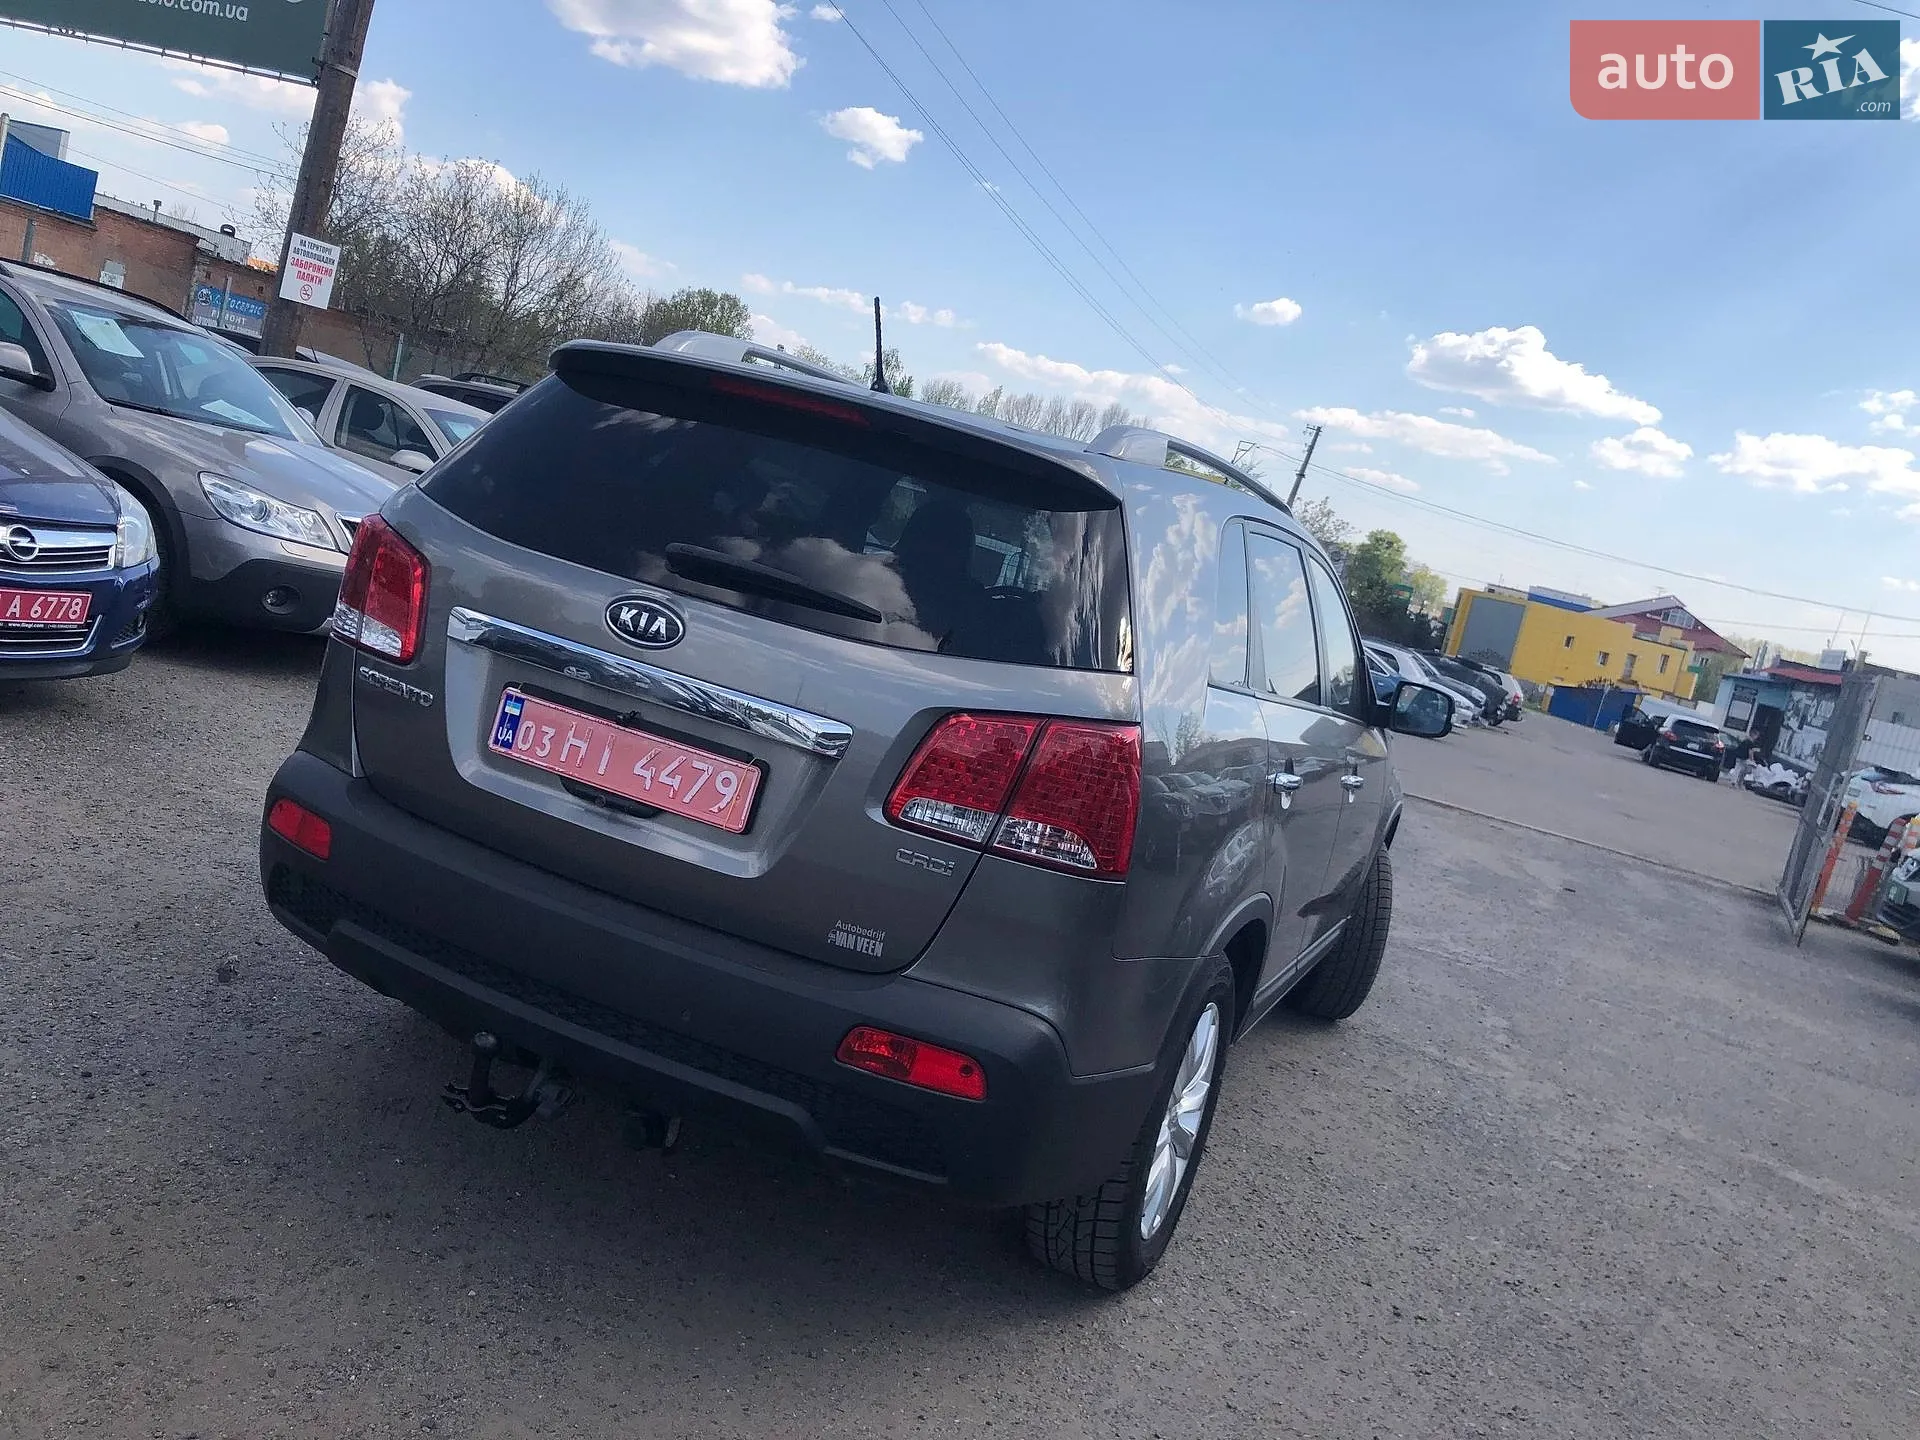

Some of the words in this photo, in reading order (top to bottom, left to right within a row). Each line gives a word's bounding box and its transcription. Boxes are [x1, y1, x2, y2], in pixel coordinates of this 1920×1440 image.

[138, 0, 249, 21] o.com.ua
[291, 256, 333, 278] ЗАБОРОНЕНО
[296, 270, 323, 286] ПАЛИТИ
[30, 596, 82, 620] 6778
[617, 605, 667, 641] KIA
[498, 726, 513, 743] UA
[517, 720, 555, 758] 03
[633, 747, 738, 814] 4479
[835, 919, 886, 942] Autobedrijf
[835, 930, 856, 950] VAN
[856, 936, 884, 957] VEEN
